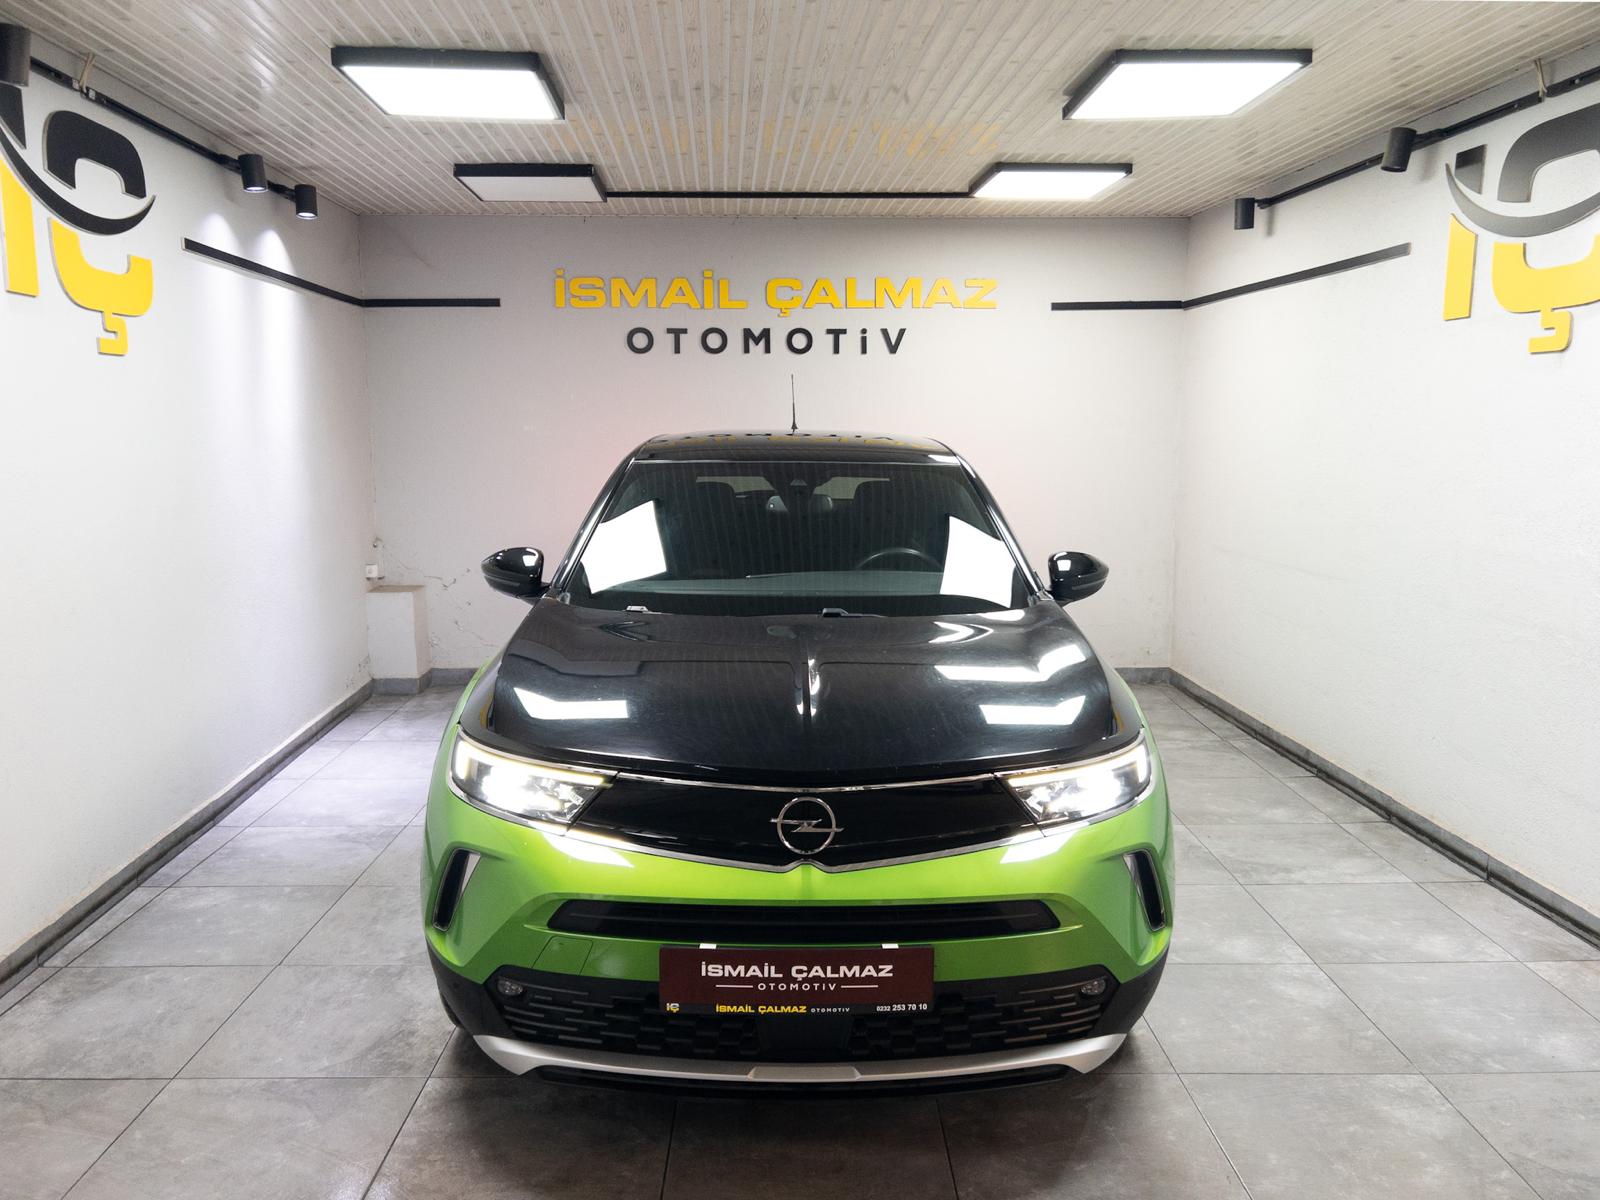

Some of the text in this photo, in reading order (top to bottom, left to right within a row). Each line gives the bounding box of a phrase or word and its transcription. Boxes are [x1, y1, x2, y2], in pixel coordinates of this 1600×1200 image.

[554, 269, 998, 318] İSMAİL ÇALMAZ
[701, 961, 893, 981] İSMAİL ÇALMAZ
[716, 1004, 755, 1013] İSMAİL
[758, 1006, 807, 1014] ÇALMAZ
[892, 1004, 906, 1012] 253
[918, 1003, 928, 1011] 10
